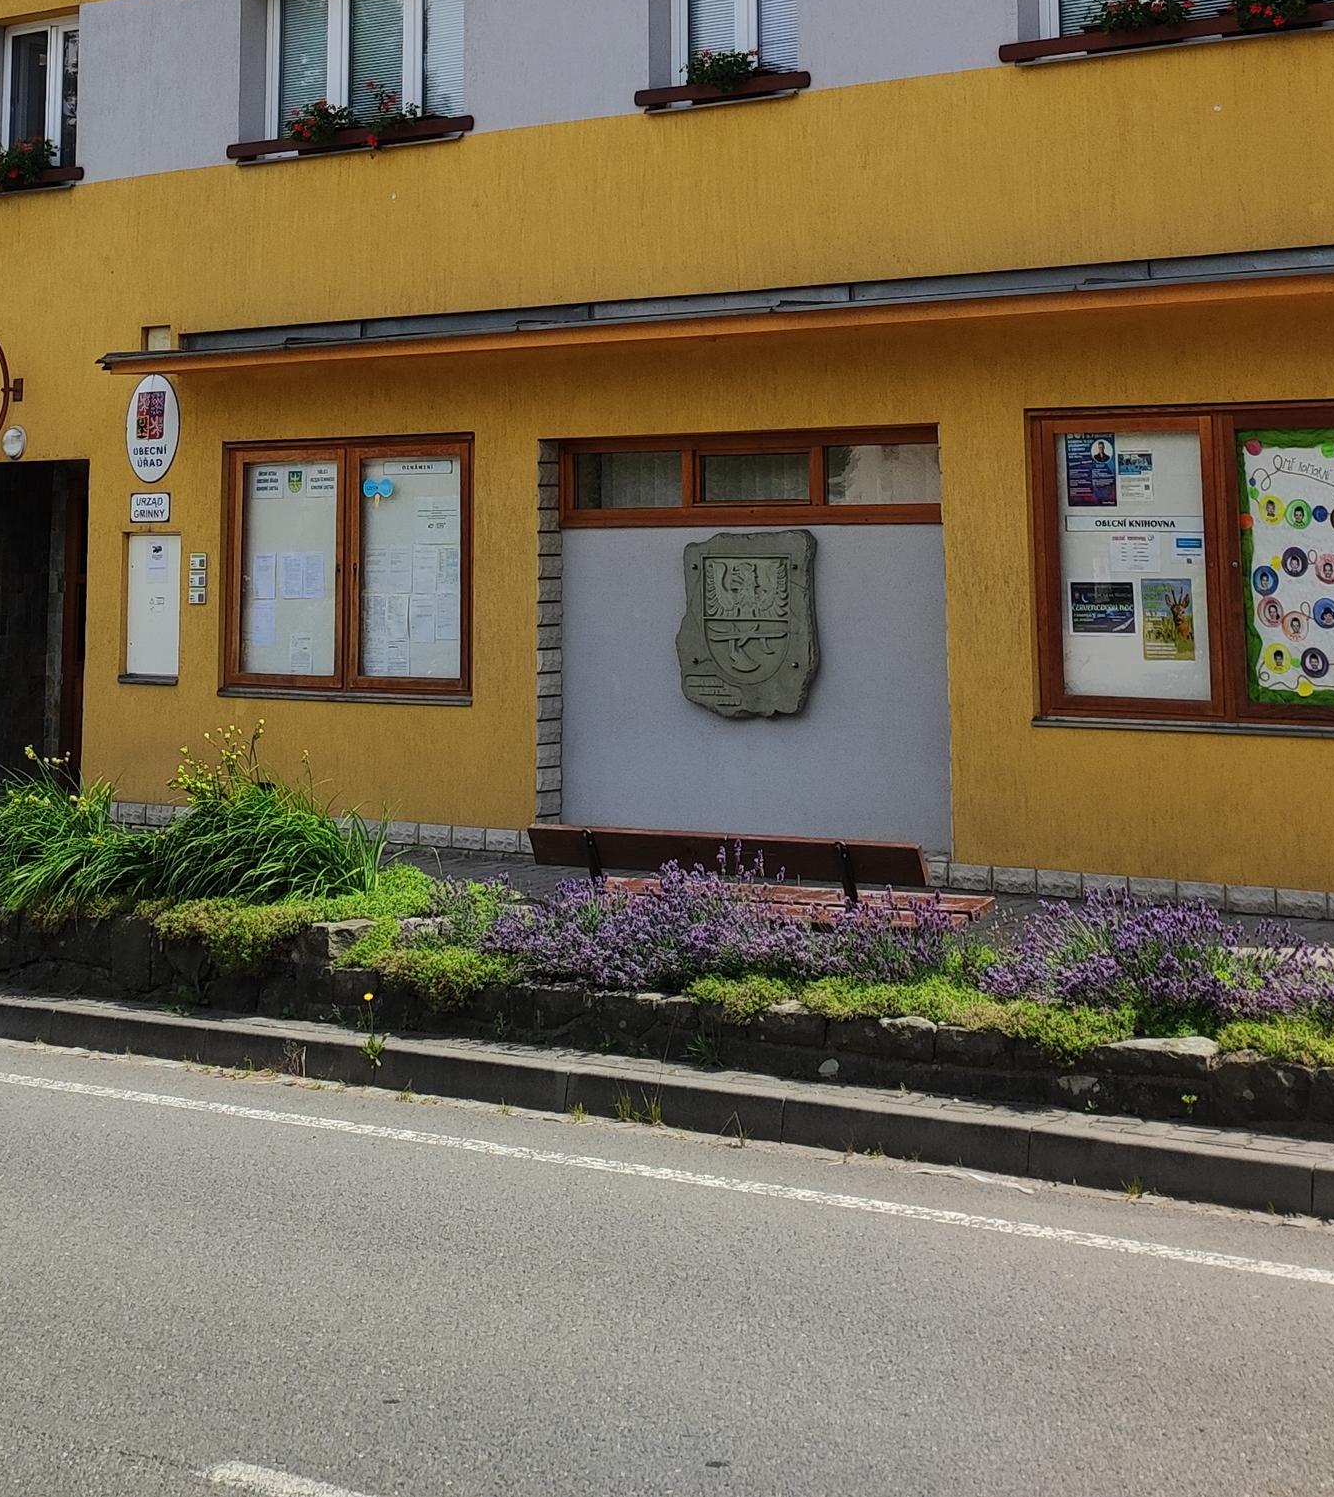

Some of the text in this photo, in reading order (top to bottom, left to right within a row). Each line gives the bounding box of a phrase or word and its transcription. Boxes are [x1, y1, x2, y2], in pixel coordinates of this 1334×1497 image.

[133, 445, 167, 455] OBECNÍ
[137, 457, 163, 468] ÚŘAD
[133, 509, 165, 519] GMINNY
[1094, 518, 1176, 528] OBECNÍ KNIHOVNA
